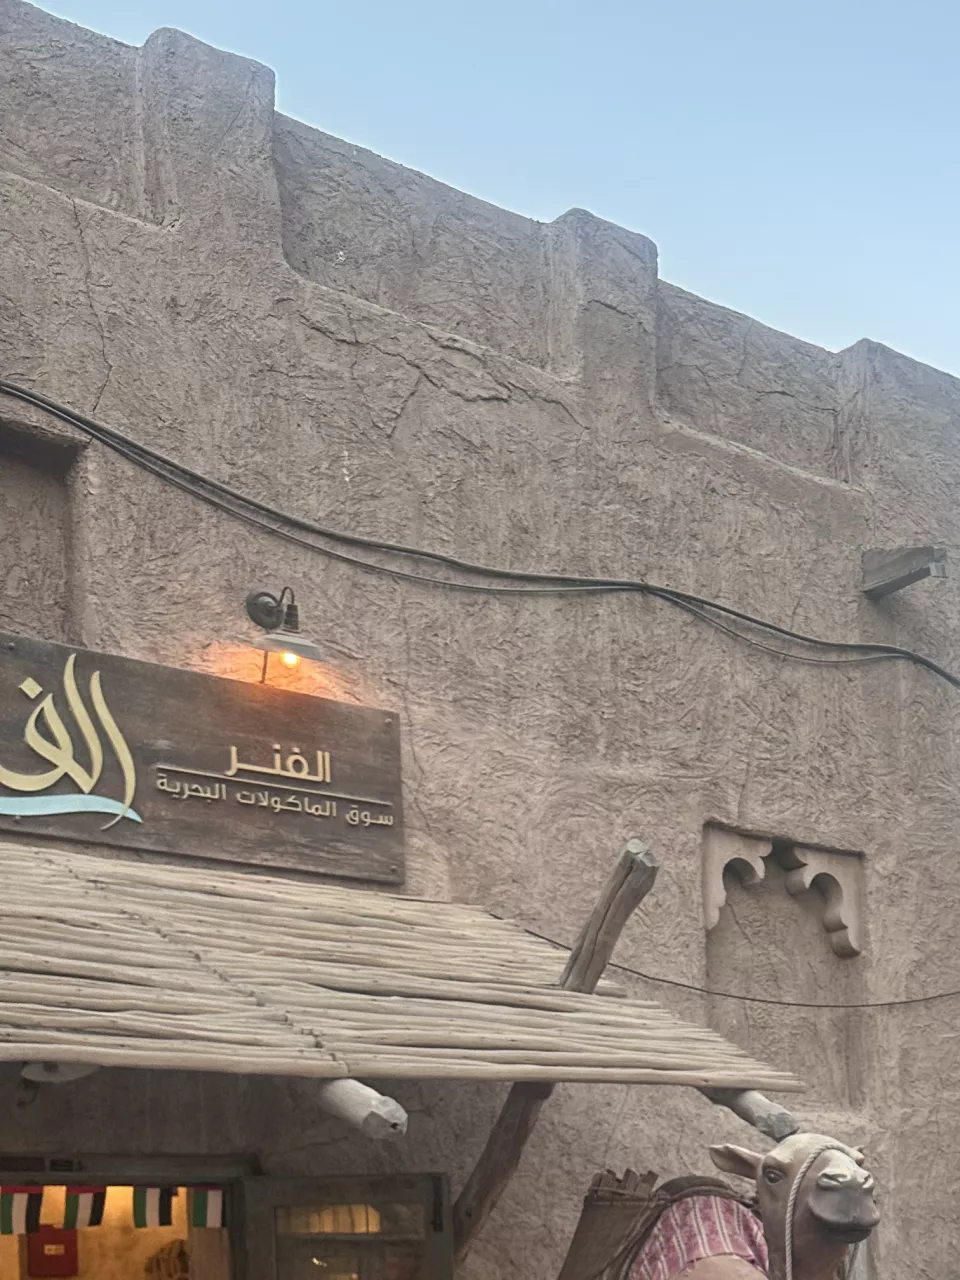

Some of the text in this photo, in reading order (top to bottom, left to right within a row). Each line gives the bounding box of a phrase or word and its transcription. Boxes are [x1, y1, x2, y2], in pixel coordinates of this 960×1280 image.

[224, 743, 332, 784] الفنر
[156, 772, 227, 802] البحرية
[345, 804, 394, 827] سوق
